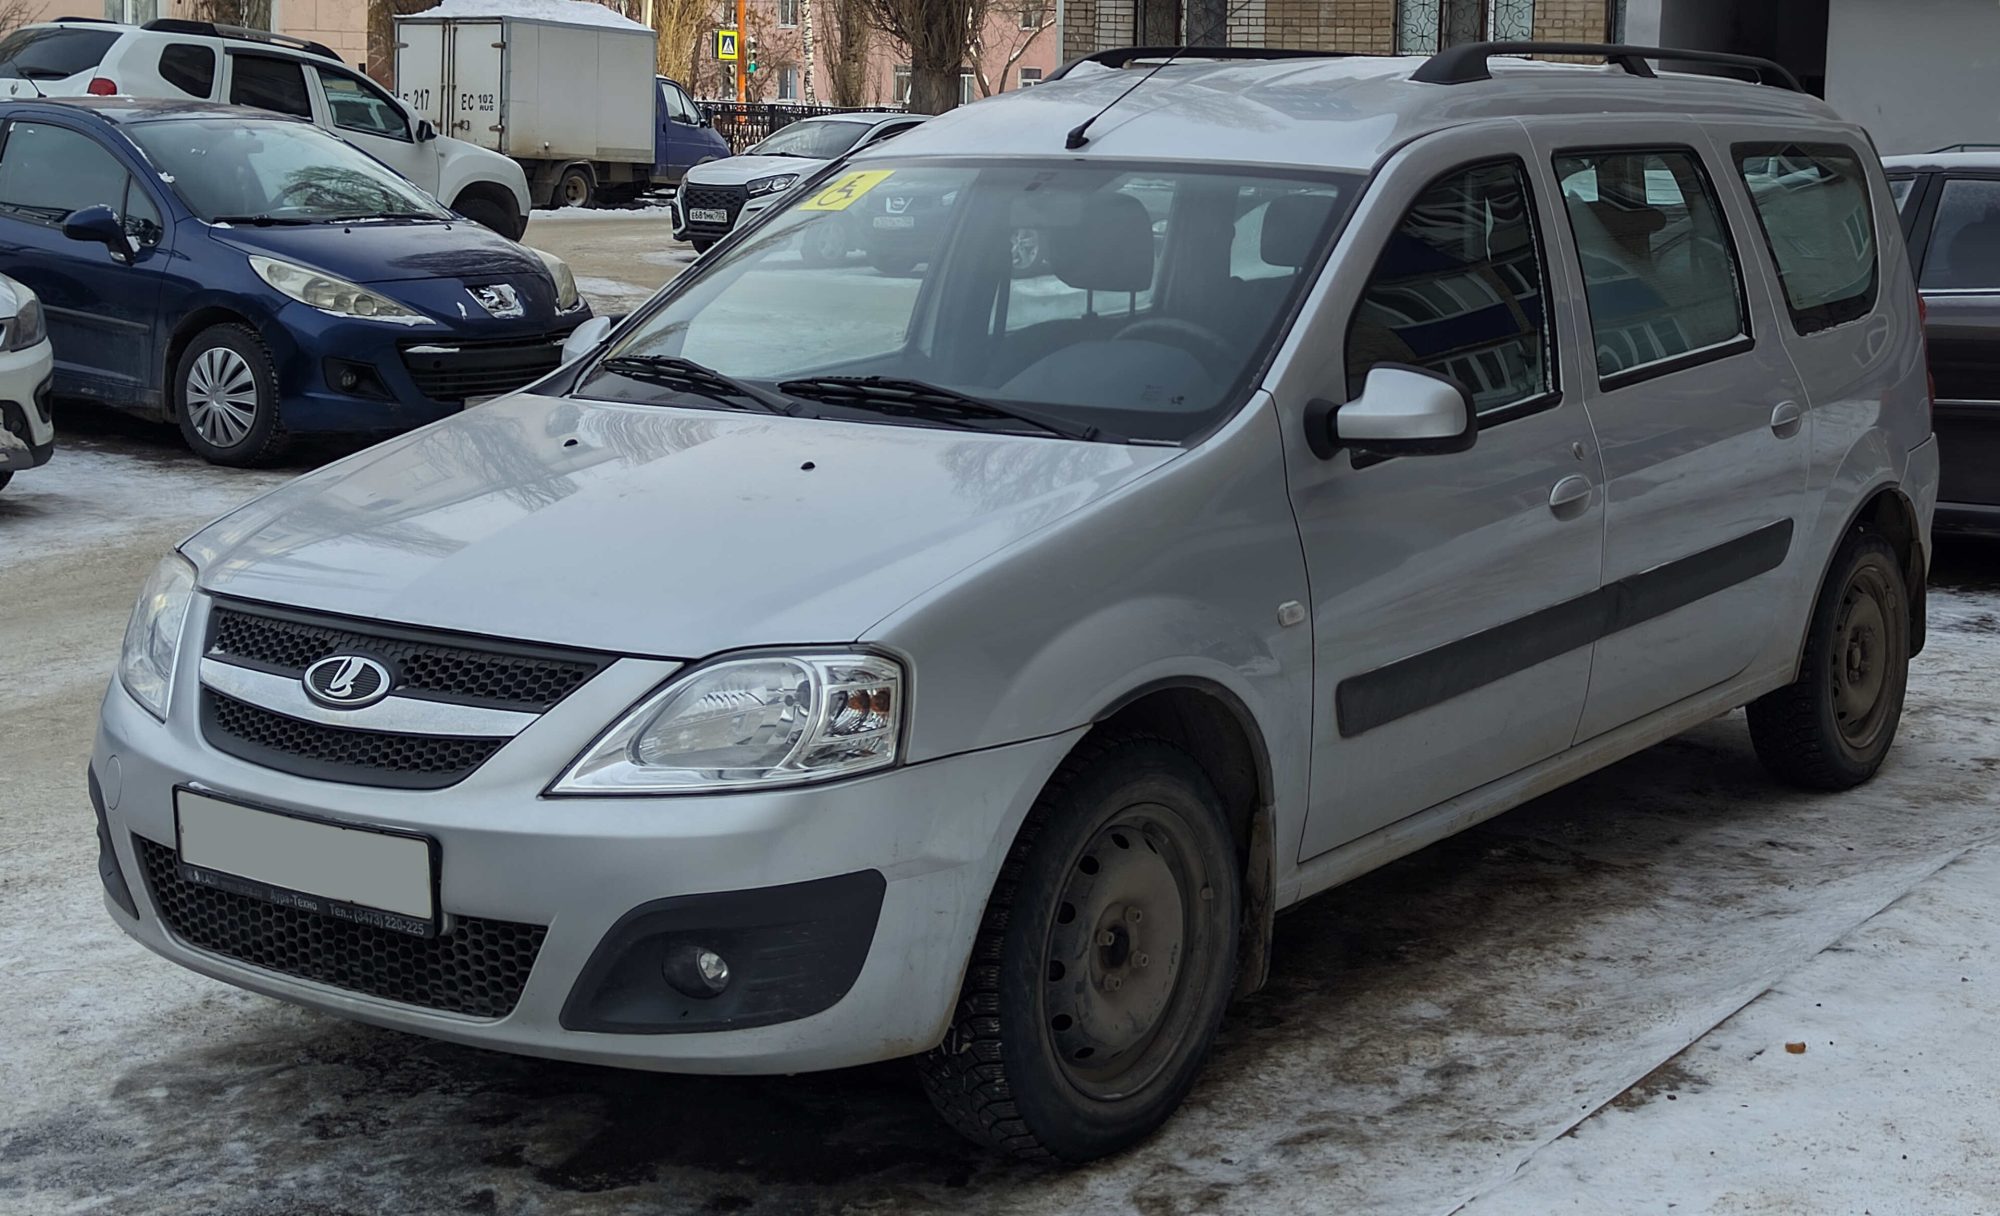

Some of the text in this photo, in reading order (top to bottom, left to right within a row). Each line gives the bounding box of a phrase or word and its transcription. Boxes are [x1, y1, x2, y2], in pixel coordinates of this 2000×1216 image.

[413, 89, 430, 110] 217
[478, 94, 494, 104] 102
[353, 909, 383, 929] (3473)
[385, 916, 425, 936] 220-225
